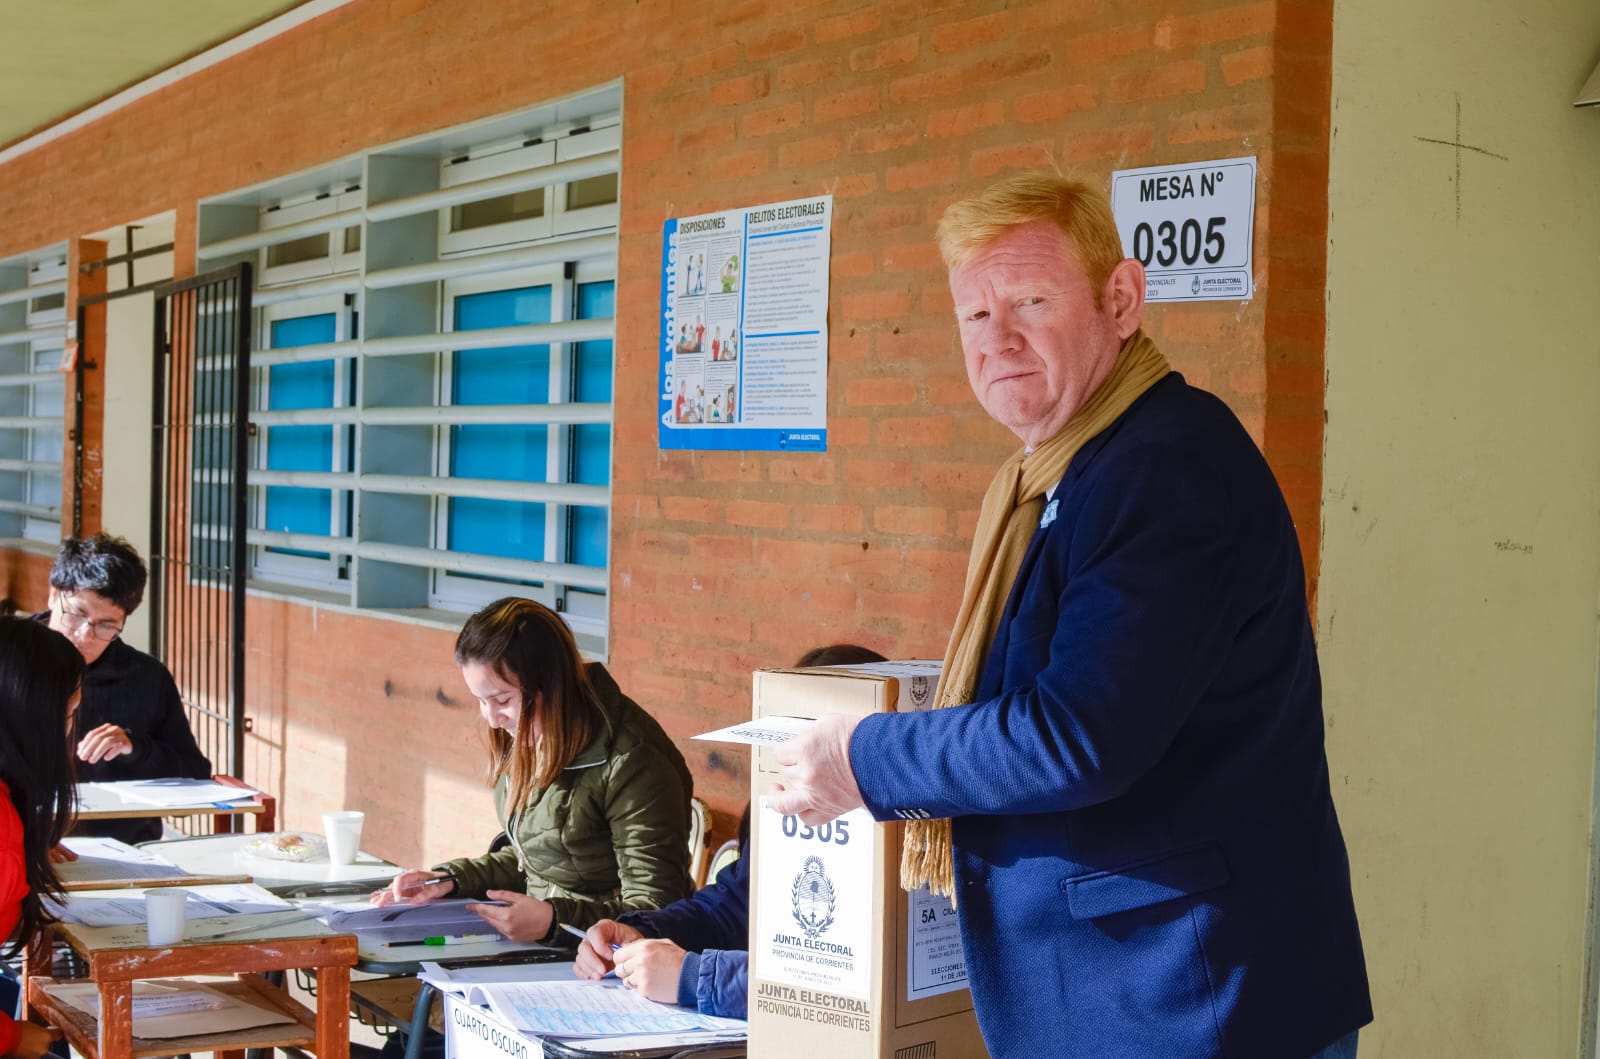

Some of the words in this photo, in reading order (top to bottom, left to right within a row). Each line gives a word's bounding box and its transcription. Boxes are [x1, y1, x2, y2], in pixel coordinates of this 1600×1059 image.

[1140, 175, 1194, 202] MESA
[749, 209, 776, 224] DELITOS
[778, 202, 825, 220] ELECTORALES
[680, 217, 726, 234] DISPOSICIONES
[1133, 217, 1226, 267] 0305
[664, 232, 677, 352] votantes
[1146, 278, 1176, 286] ROVINCIALES
[662, 361, 673, 400] los
[662, 409, 674, 429] A
[921, 907, 937, 924] 5A
[772, 934, 801, 947] JUNTA
[804, 939, 854, 957] ELECTORAL
[772, 949, 805, 961] PROVINCIA
[806, 955, 814, 963] DE
[816, 957, 854, 971] CORRIENTES
[931, 962, 963, 975] ELECCIONES
[956, 970, 966, 978] JUN
[757, 984, 797, 1001] JUNTA
[800, 991, 871, 1014] ELECTORAL
[757, 1000, 802, 1019] PROVINCIA
[803, 1008, 815, 1021] DE
[817, 1011, 871, 1032] CORRIENTES
[454, 1008, 489, 1041] CUARTO
[491, 1028, 528, 1059] OSCURO
